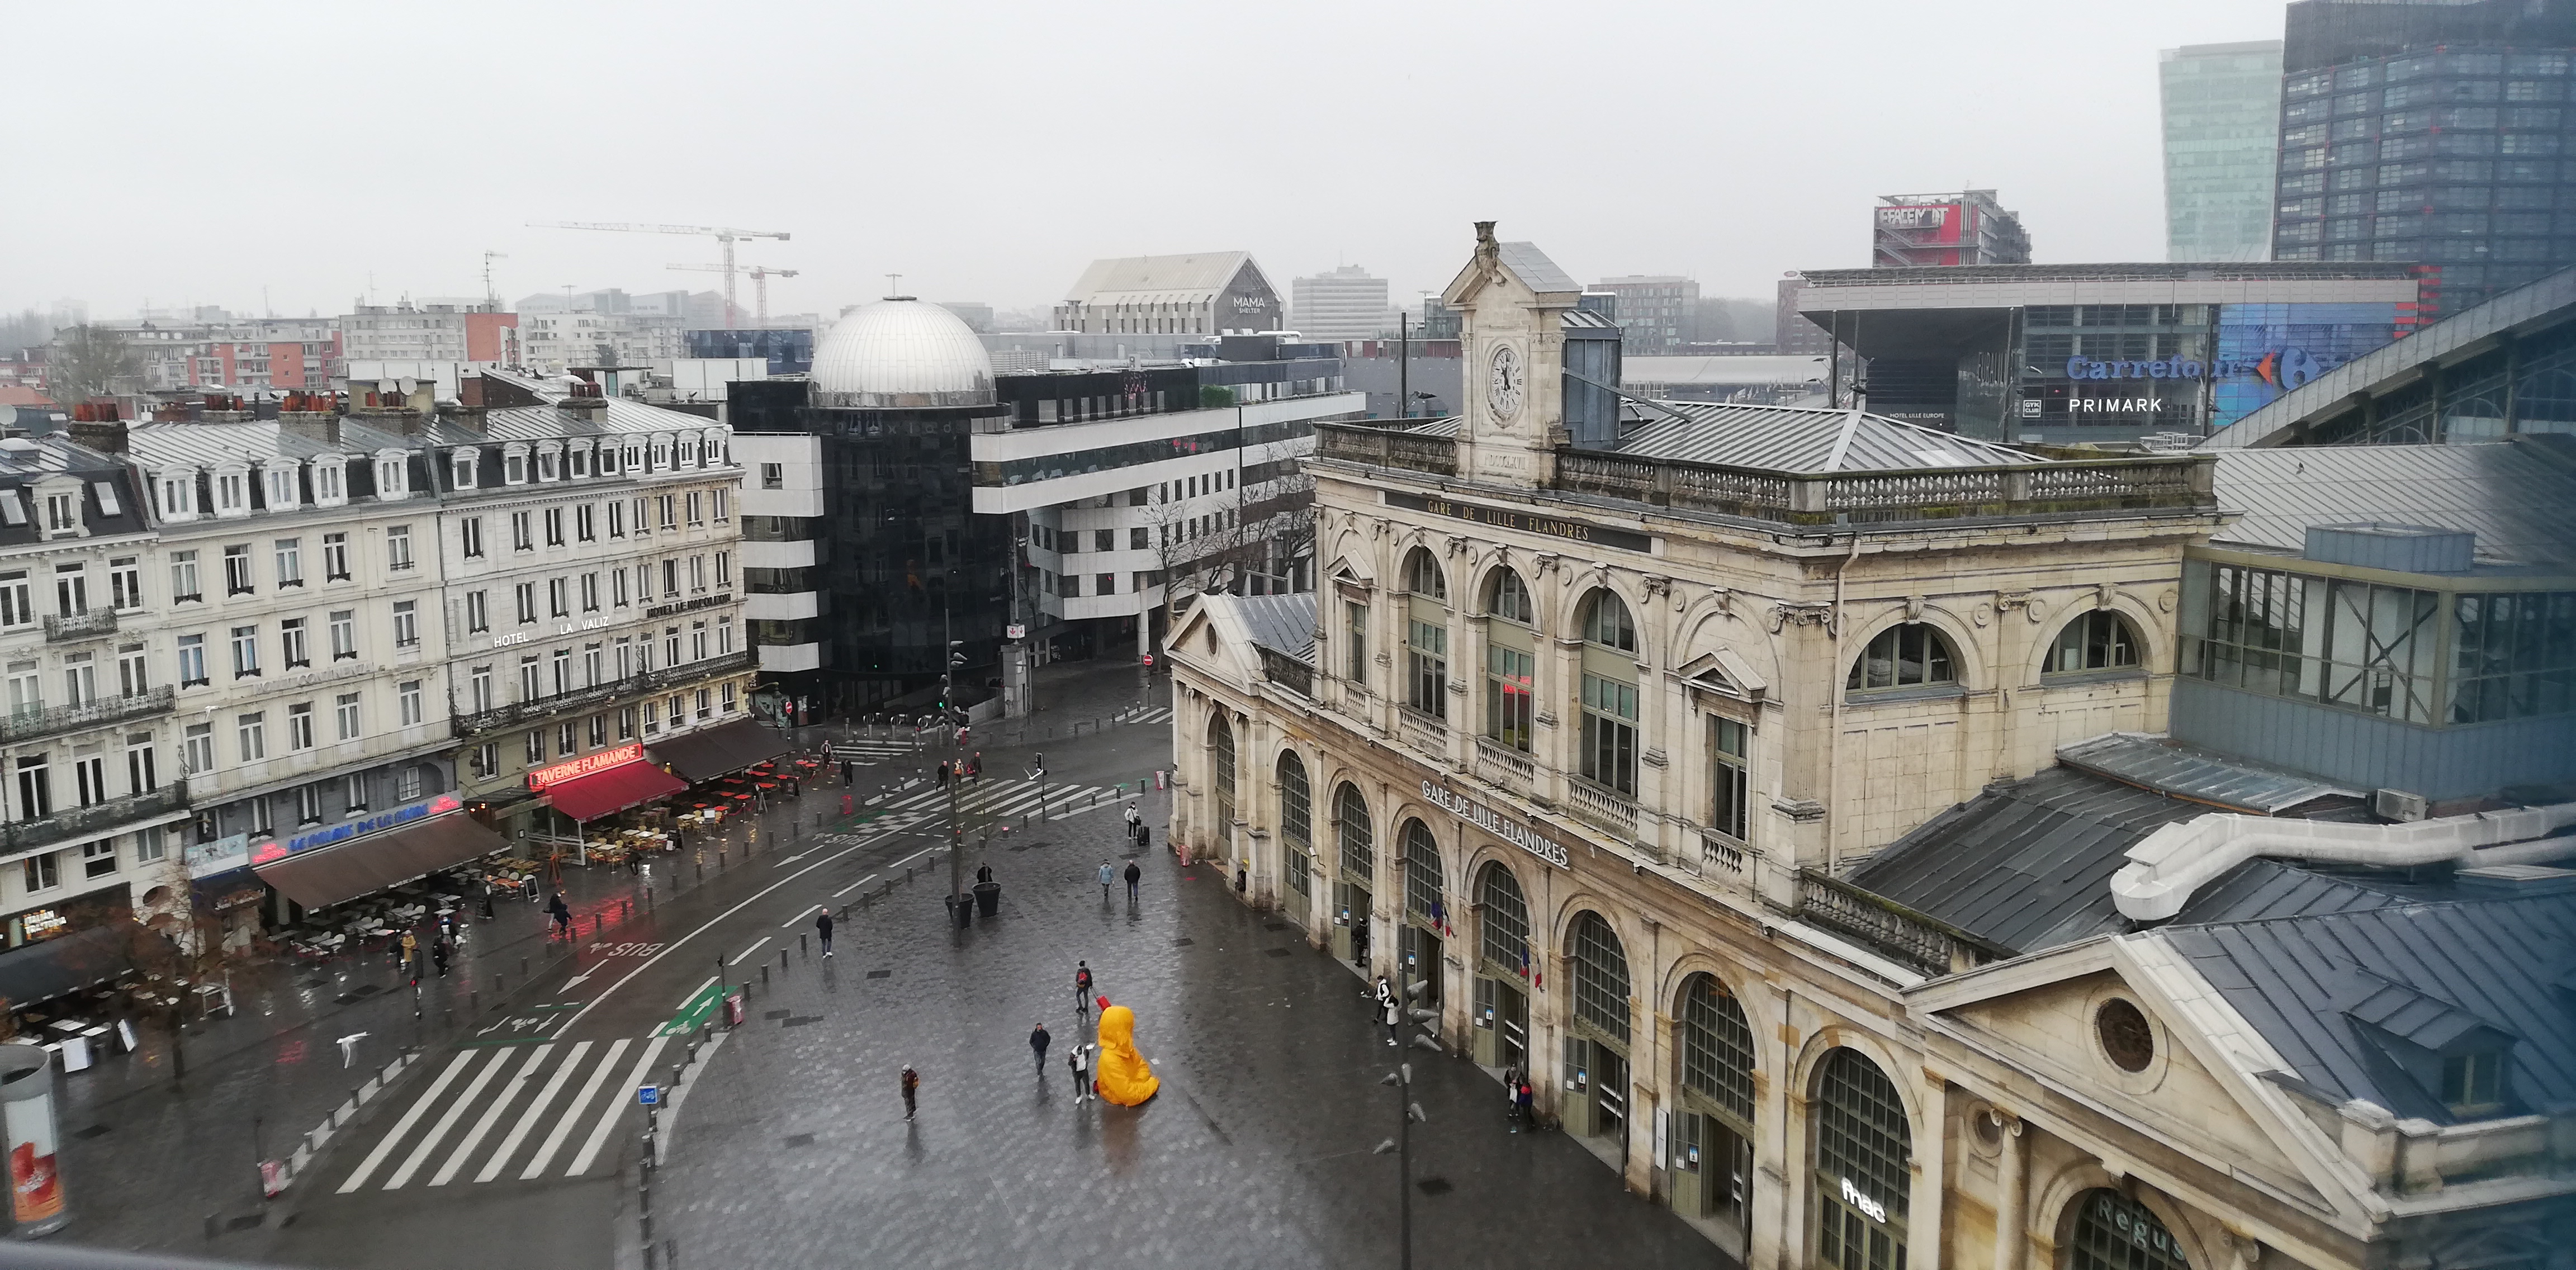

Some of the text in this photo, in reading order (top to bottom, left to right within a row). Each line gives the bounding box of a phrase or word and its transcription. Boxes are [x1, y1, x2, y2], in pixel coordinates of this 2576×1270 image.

[1233, 297, 1265, 307] MAMA
[2069, 398, 2162, 413] PRIMARK
[1428, 500, 1589, 541] GARE DE LILLE FLANDRES
[494, 617, 609, 647] HOTEL LA VALIZ
[536, 747, 636, 784] TAVERNE FLAMANDE
[1422, 780, 1569, 866] GARE DE LILLE FLANDRES
[608, 942, 665, 956] BUS
[1842, 1178, 1886, 1224] fnac
[2099, 1193, 2185, 1260] Regus
